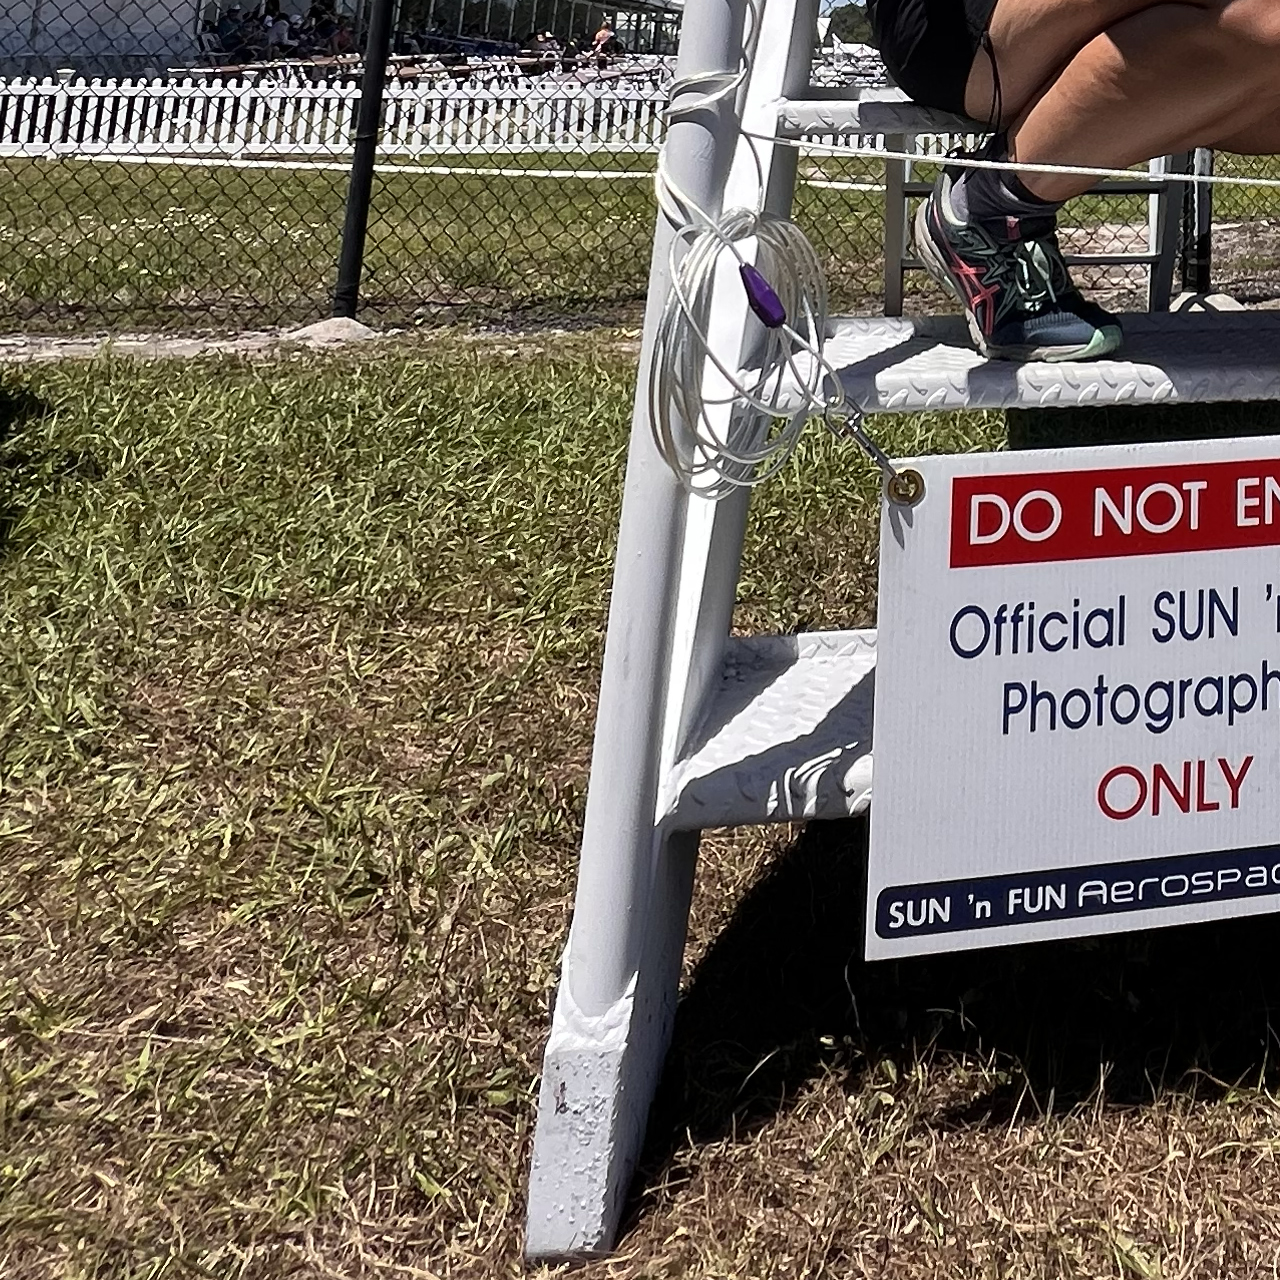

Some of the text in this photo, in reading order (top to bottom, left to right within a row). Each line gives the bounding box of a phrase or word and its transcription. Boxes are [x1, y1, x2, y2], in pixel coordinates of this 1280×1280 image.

[969, 490, 1062, 545] DO
[1094, 480, 1208, 537] NOT
[949, 594, 1126, 660] Official
[1151, 586, 1239, 644] SUN
[1096, 756, 1252, 820] ONLY
[888, 896, 951, 929] SUN
[967, 893, 991, 919] 'n
[1008, 883, 1066, 915] FUN
